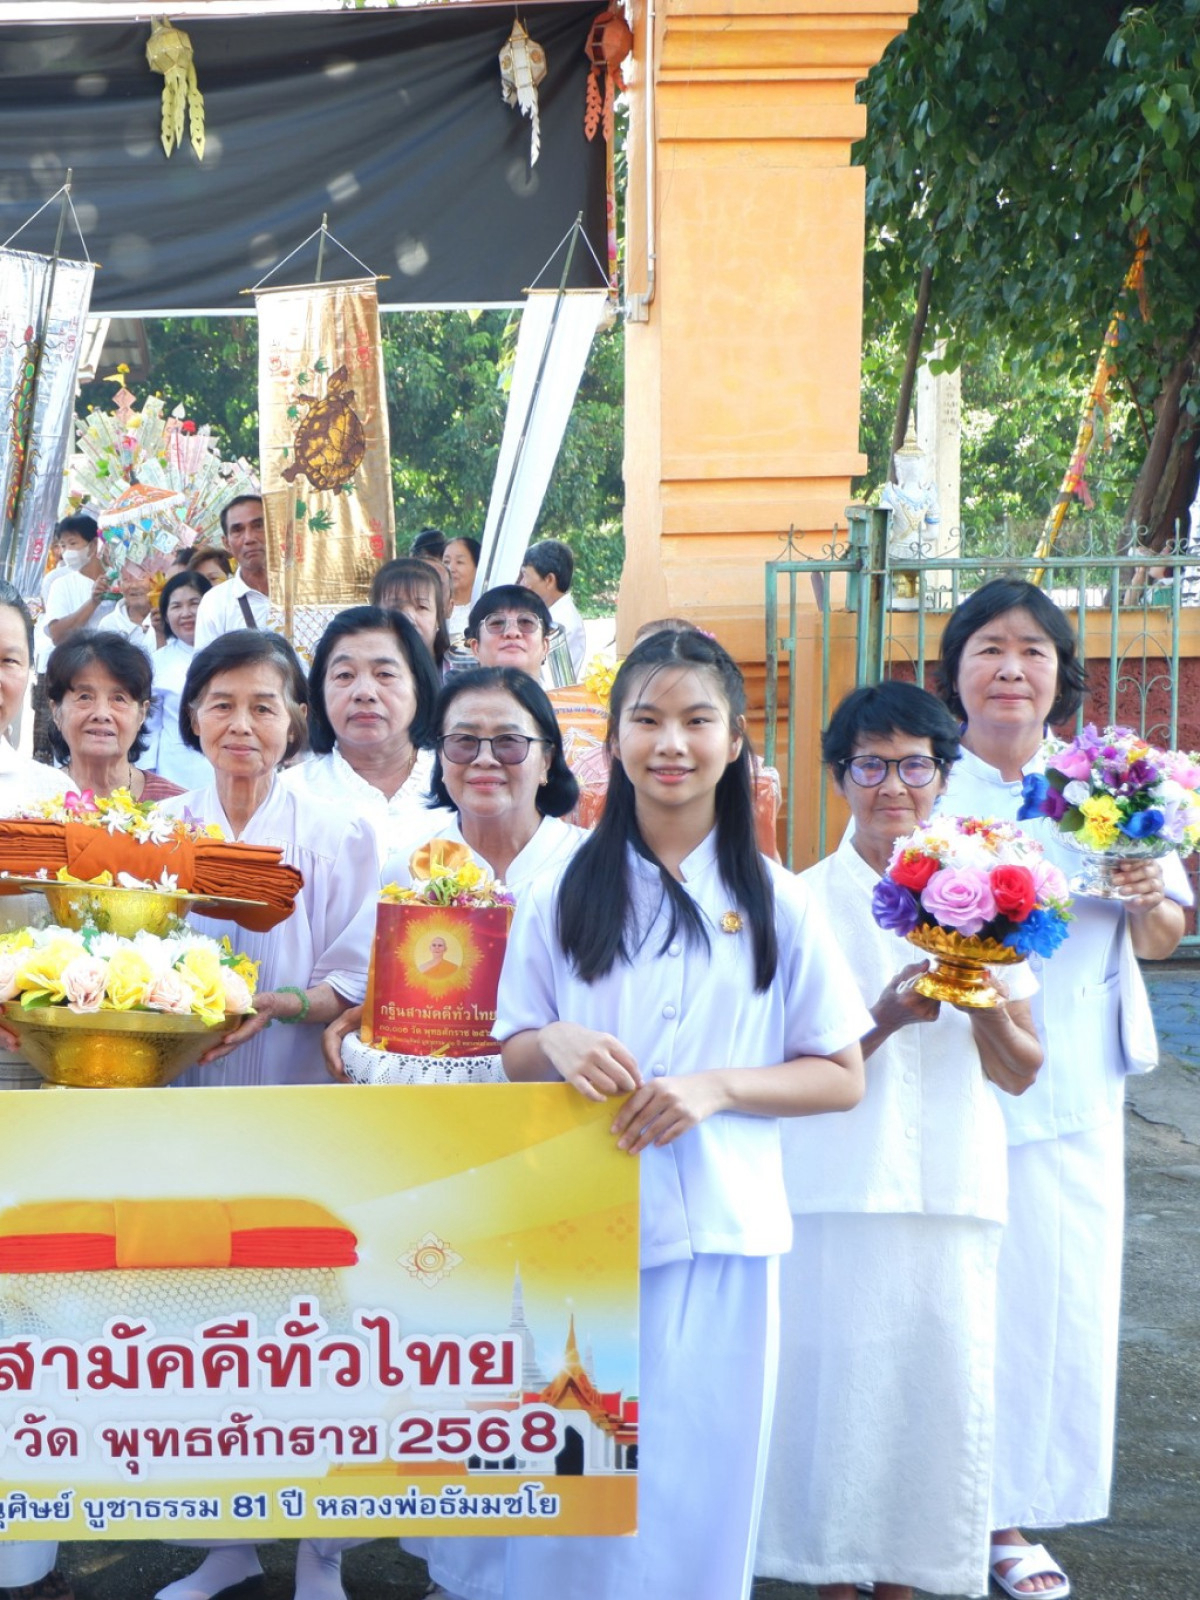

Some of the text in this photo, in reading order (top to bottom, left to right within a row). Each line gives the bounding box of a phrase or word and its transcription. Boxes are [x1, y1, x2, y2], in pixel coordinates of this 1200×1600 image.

[13, 1412, 79, 1458] วัด
[101, 1411, 379, 1476] พุทธศักราช
[397, 1410, 558, 1455] 2568
[84, 1494, 219, 1529] บูชาธรรม
[233, 1495, 267, 1518] 81
[280, 1489, 304, 1517] ปี
[316, 1484, 558, 1518] หลวงพ่อธัมมชโย
